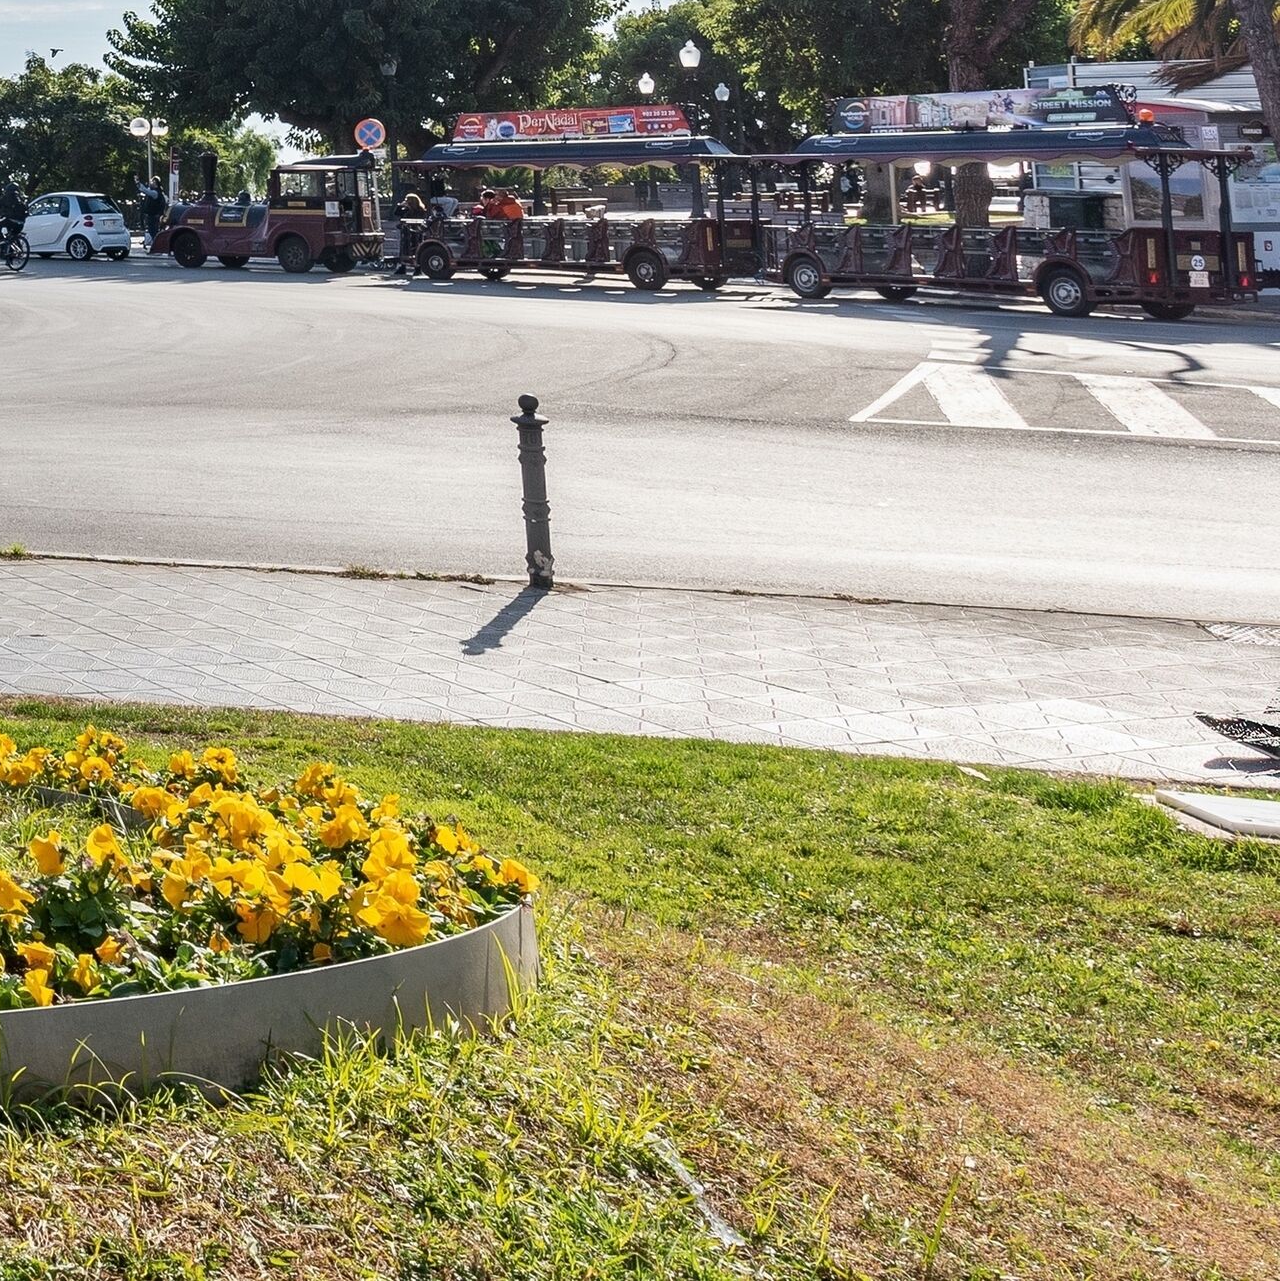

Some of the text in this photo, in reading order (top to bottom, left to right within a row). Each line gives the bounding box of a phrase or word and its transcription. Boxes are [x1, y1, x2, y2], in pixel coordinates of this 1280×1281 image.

[1031, 99, 1111, 109] STREET MISSION
[1193, 259, 1203, 267] 25
